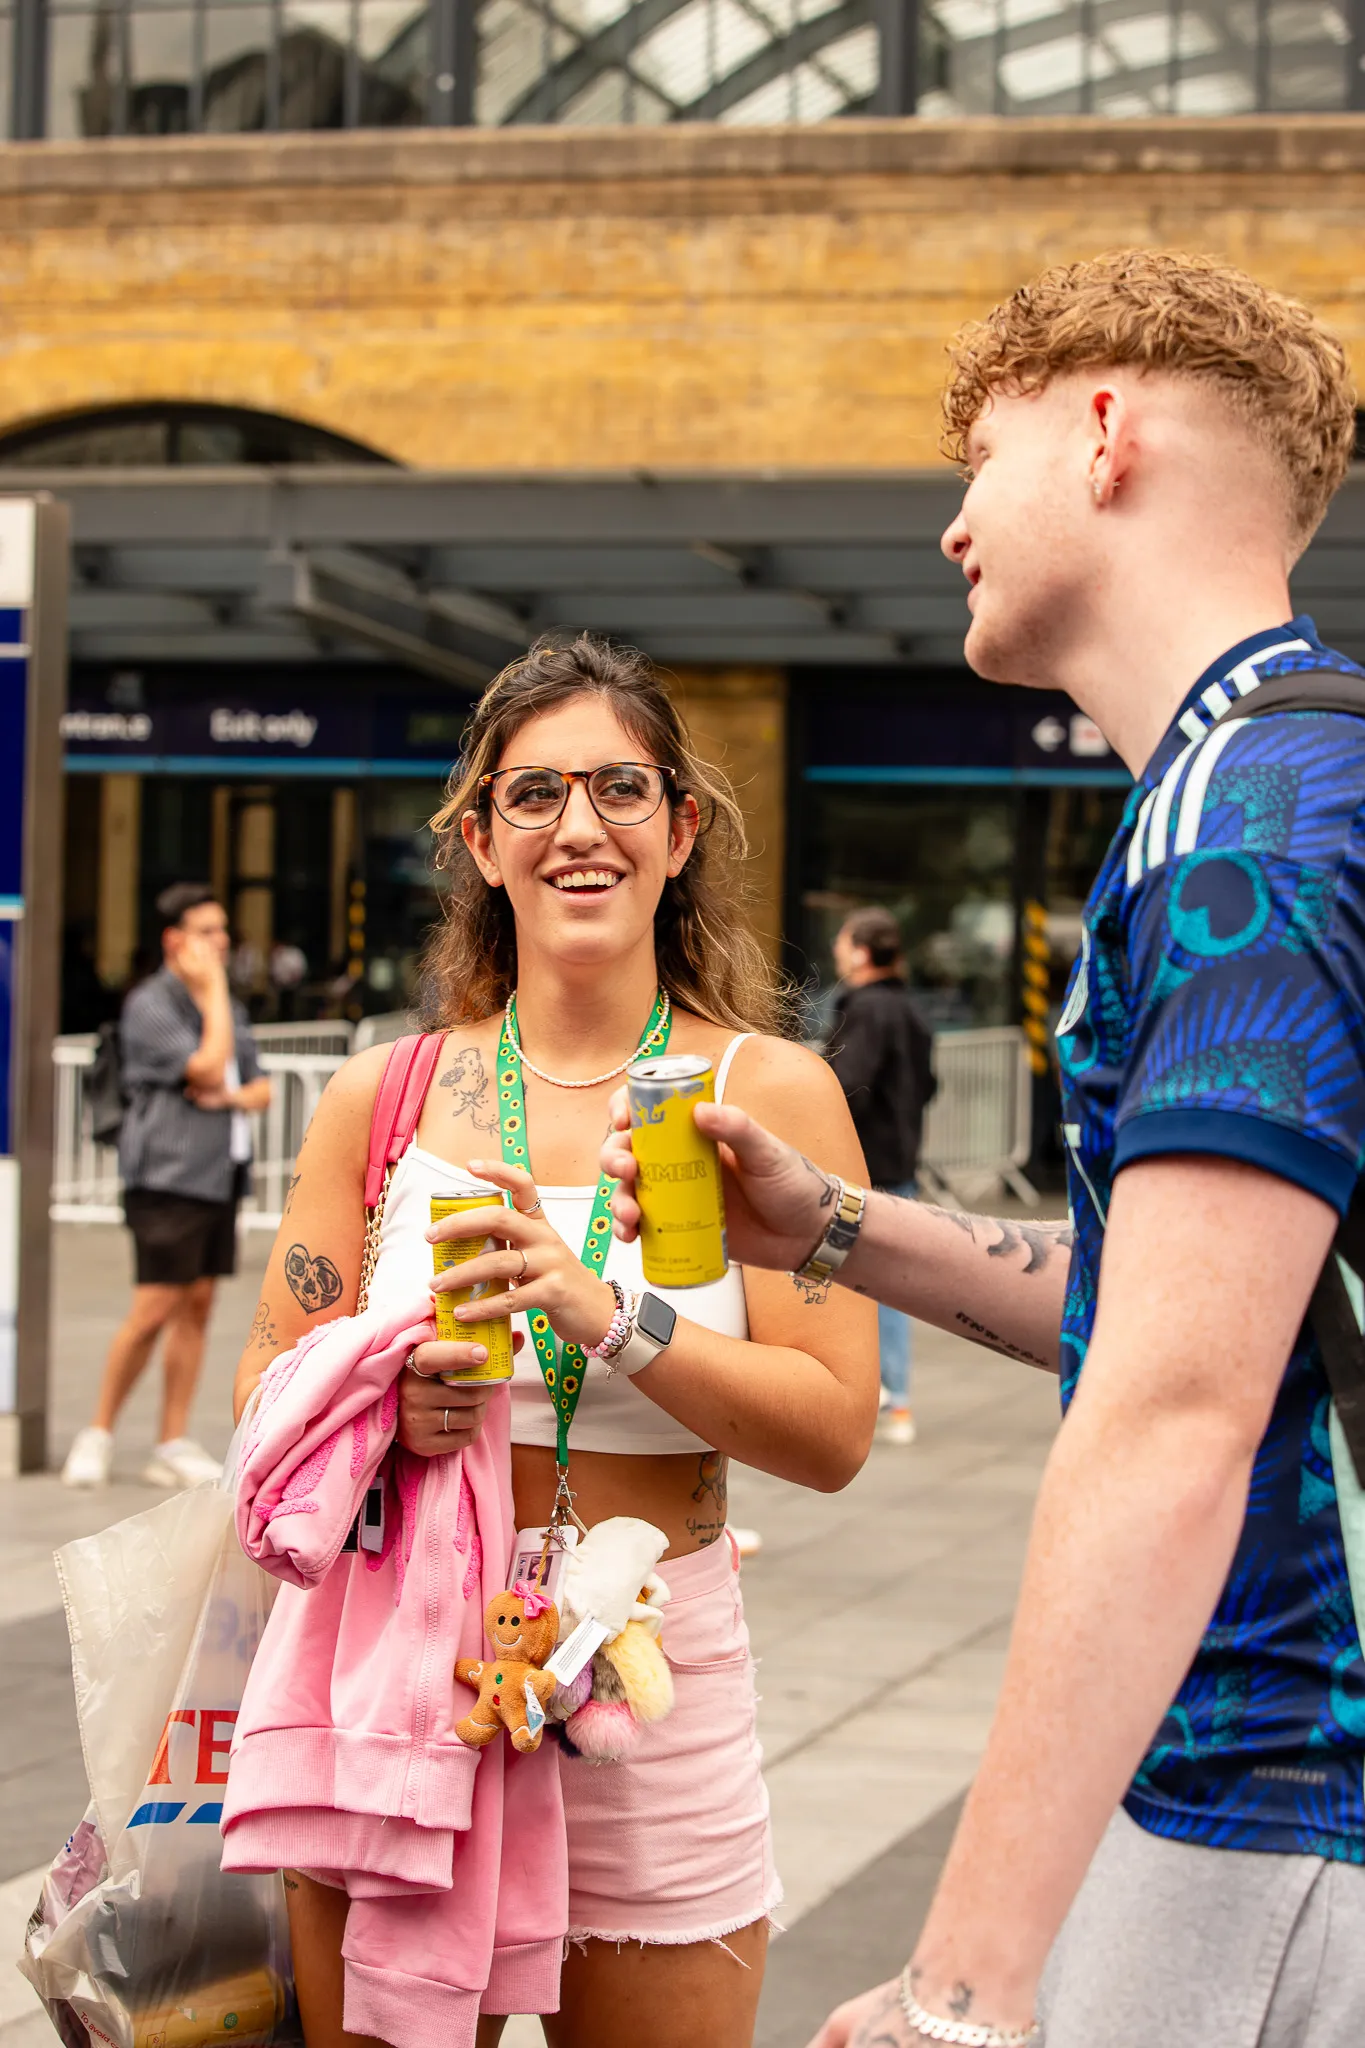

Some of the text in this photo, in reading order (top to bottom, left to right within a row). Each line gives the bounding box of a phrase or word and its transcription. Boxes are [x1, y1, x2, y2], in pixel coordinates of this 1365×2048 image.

[60, 712, 152, 740] ntrance
[81, 2011, 89, 2024] To
[89, 2023, 110, 2043] avoid
